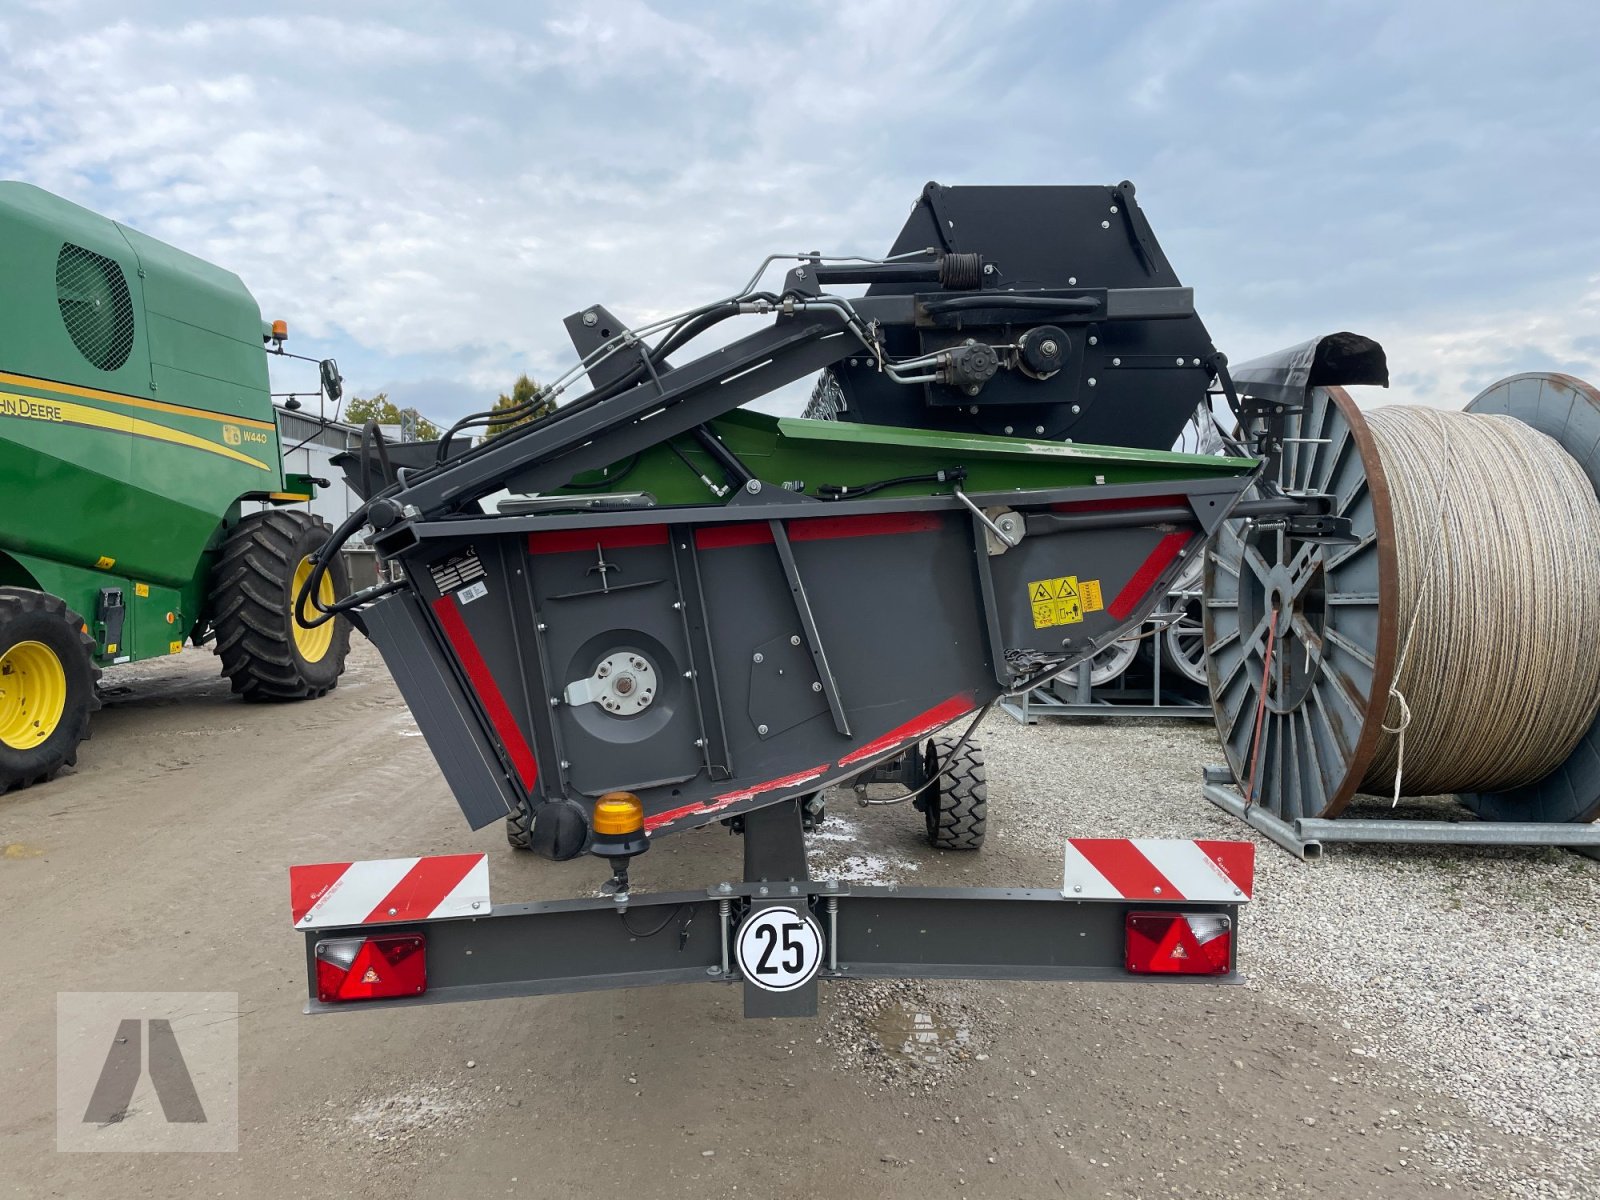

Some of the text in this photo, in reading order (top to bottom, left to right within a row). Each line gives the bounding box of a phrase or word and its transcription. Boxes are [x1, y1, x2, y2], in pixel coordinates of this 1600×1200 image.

[19, 399, 62, 420] DEERE
[243, 430, 267, 444] W440
[755, 923, 804, 975] 25
